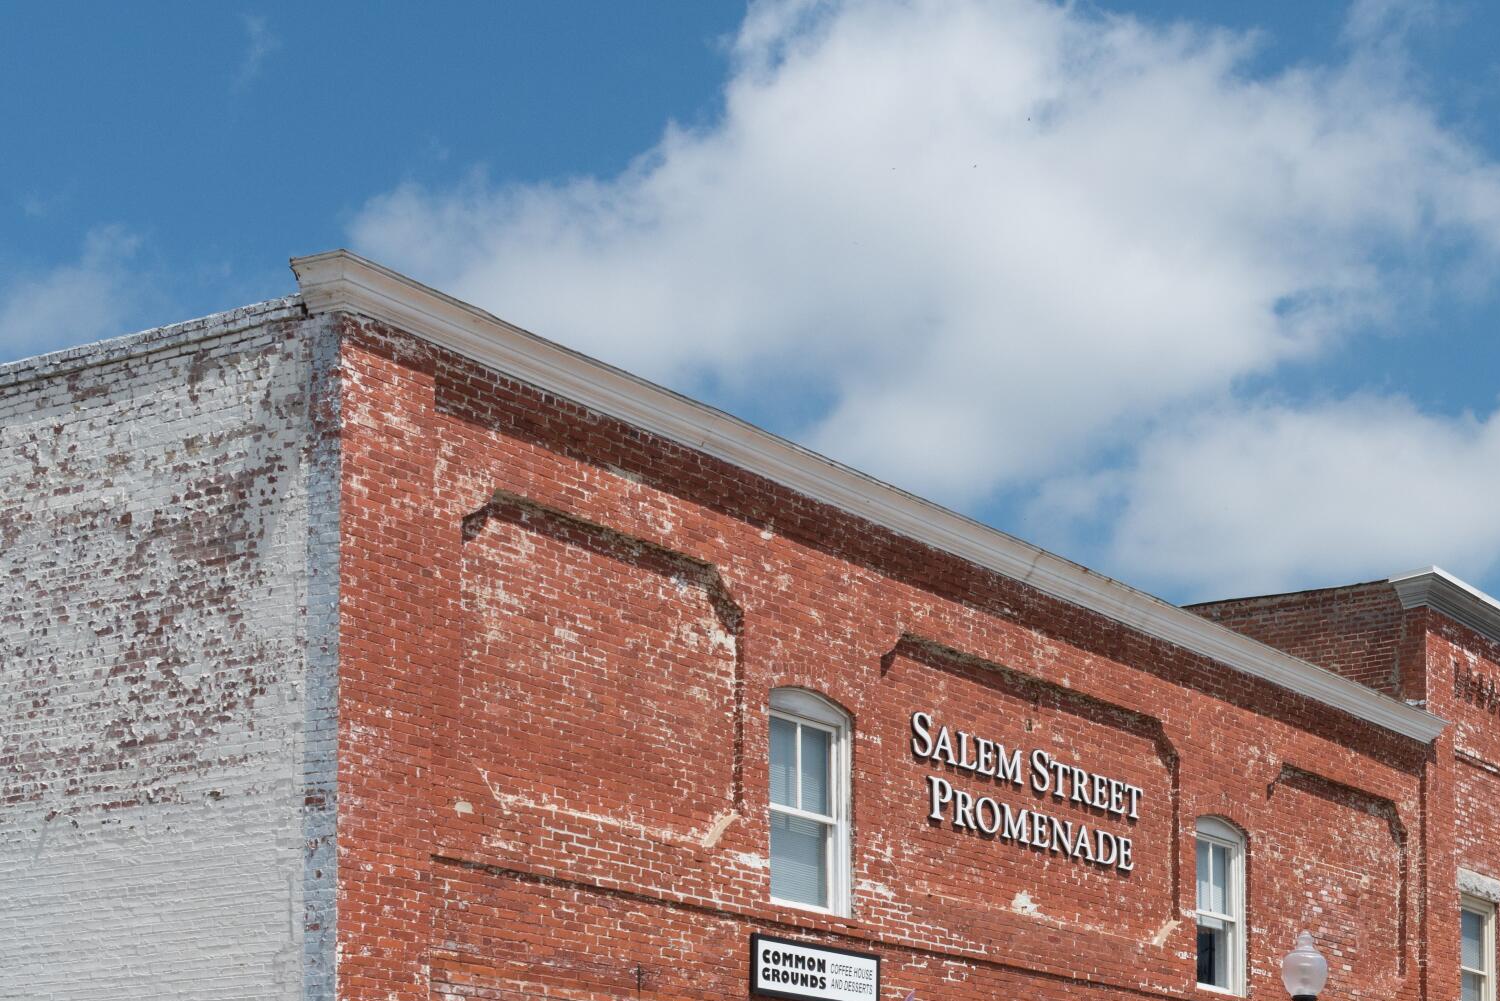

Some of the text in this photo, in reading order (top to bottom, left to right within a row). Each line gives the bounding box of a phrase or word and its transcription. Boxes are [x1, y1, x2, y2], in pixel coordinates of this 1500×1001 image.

[912, 711, 1144, 819] SALEM STREET
[927, 775, 1135, 871] PROMENADE
[762, 949, 826, 974] COMMON
[830, 963, 873, 981] COFFEE HOUSE
[762, 967, 827, 990] GROUNDS
[831, 979, 873, 995] AND DESSERTS
